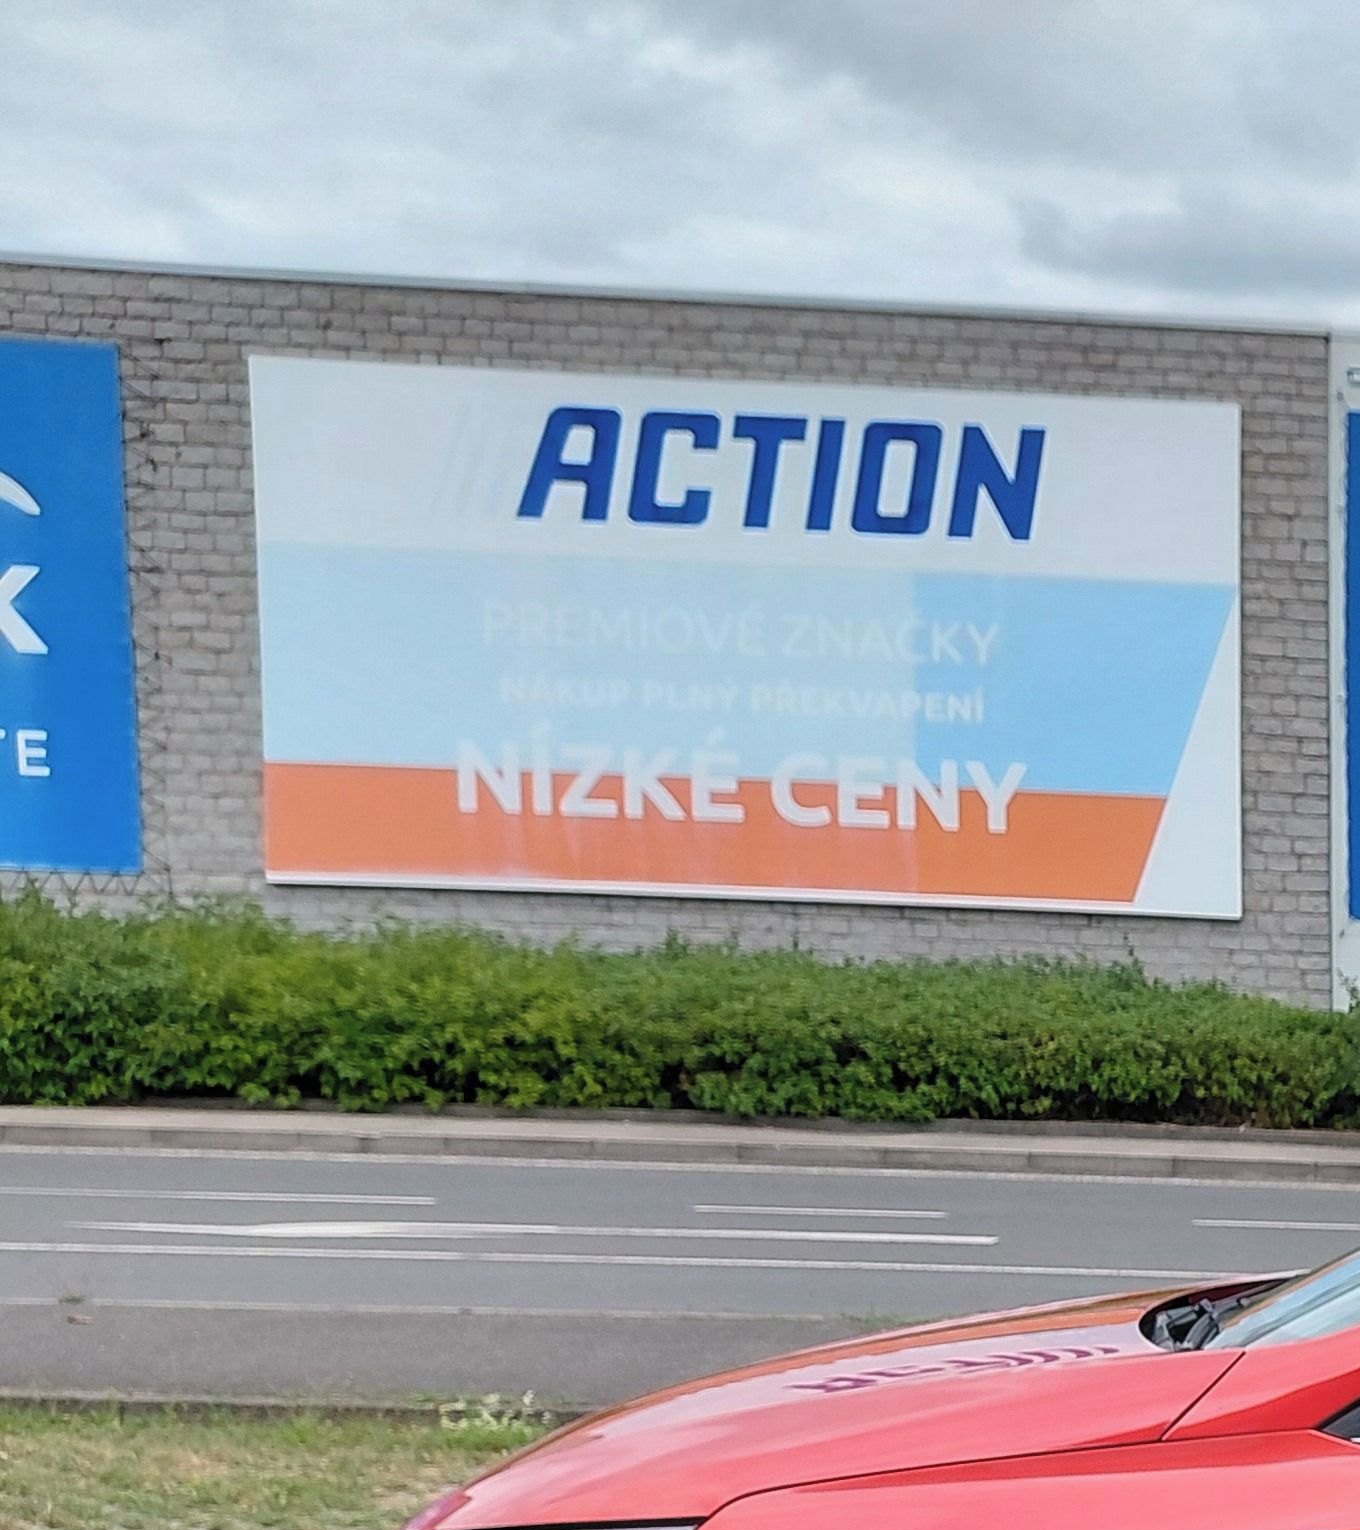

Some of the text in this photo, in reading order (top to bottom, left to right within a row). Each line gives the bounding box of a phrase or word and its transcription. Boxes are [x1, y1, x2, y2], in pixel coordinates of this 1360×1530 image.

[516, 406, 1047, 543] ACTION
[782, 604, 998, 667] ZNAČKY
[751, 680, 985, 723] PŘEKVAPENÍ
[455, 718, 1028, 836] NÍZKÉ CENY
